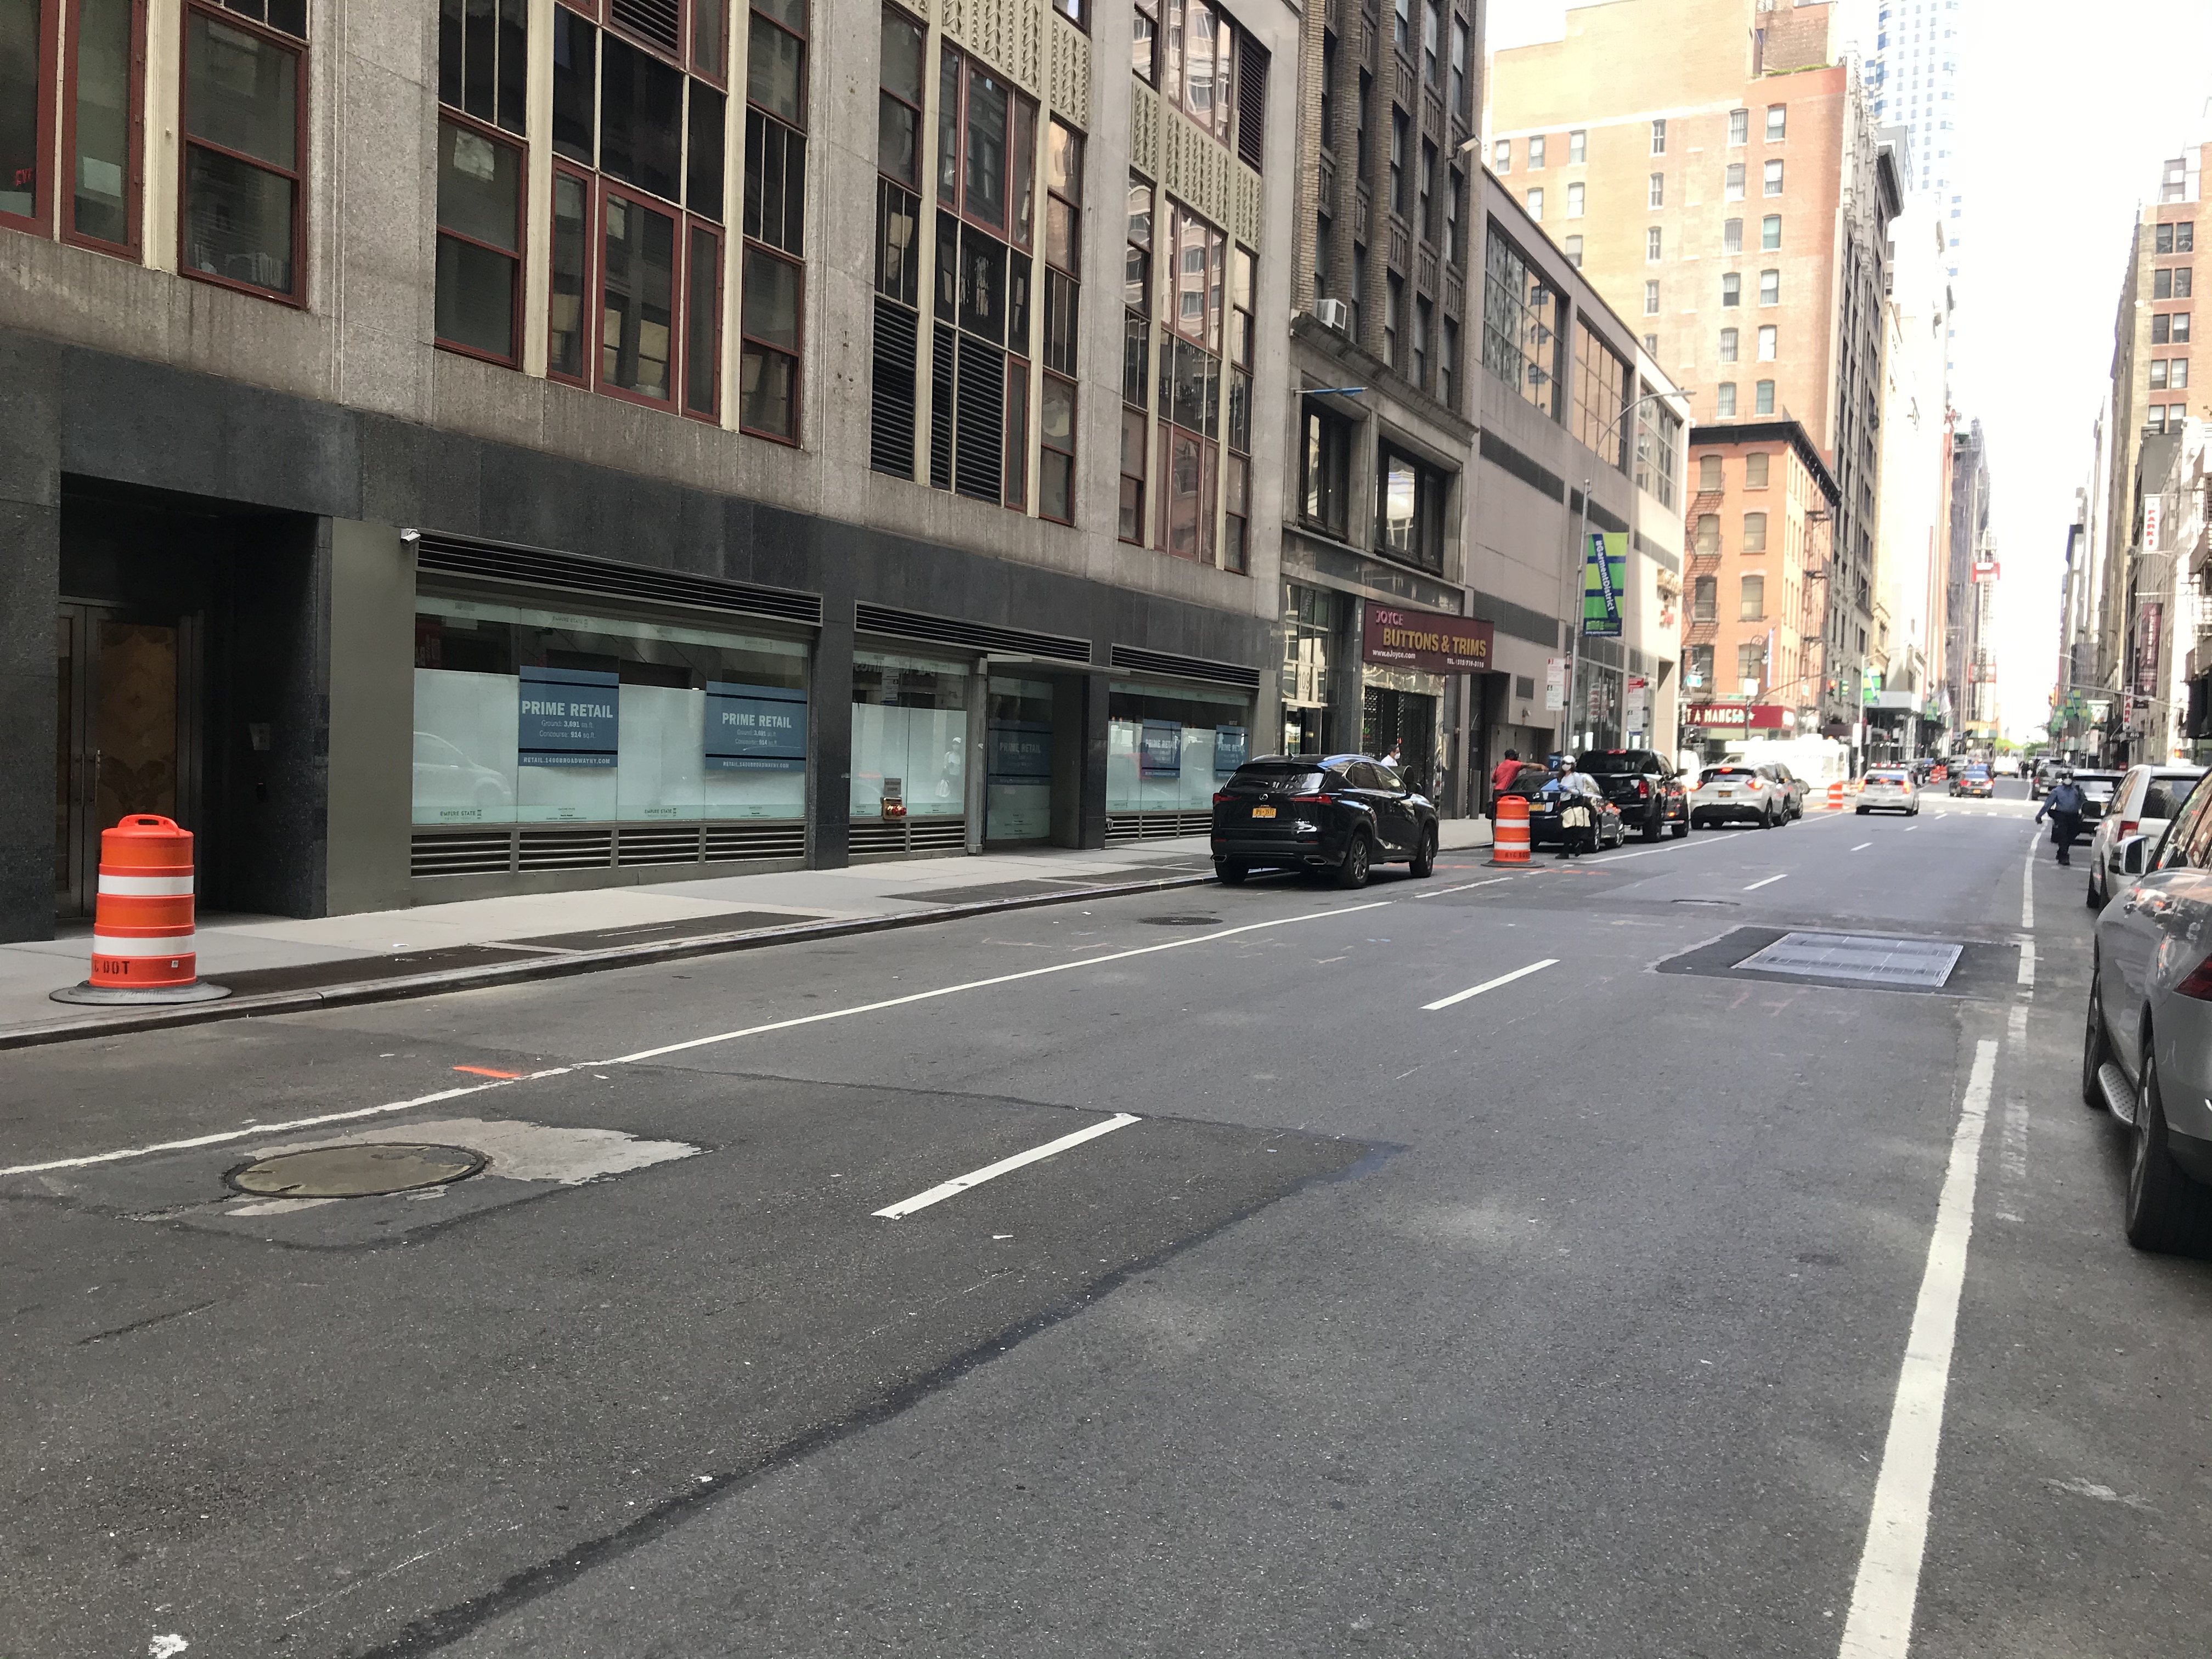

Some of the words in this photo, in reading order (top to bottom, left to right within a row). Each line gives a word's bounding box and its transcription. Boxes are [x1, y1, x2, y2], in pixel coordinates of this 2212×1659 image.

[2146, 510, 2155, 537] PARK
[1596, 540, 1615, 611] #GarmentDistrict
[1376, 610, 1403, 625] JOYCE
[1383, 628, 1438, 652] BUTTONS
[1441, 635, 1449, 653] &
[1453, 636, 1486, 657] TRIMS
[1373, 649, 1416, 660] www.eJoyce.com
[522, 700, 565, 715] PRIME
[570, 703, 613, 718] RETAIL
[722, 713, 755, 726] PRIME
[759, 715, 792, 728] RETAIL
[1000, 742, 1020, 753] PRIME
[1021, 743, 1041, 753] RETAIL
[1146, 739, 1161, 748] PRIME
[103, 961, 130, 975] DOT
